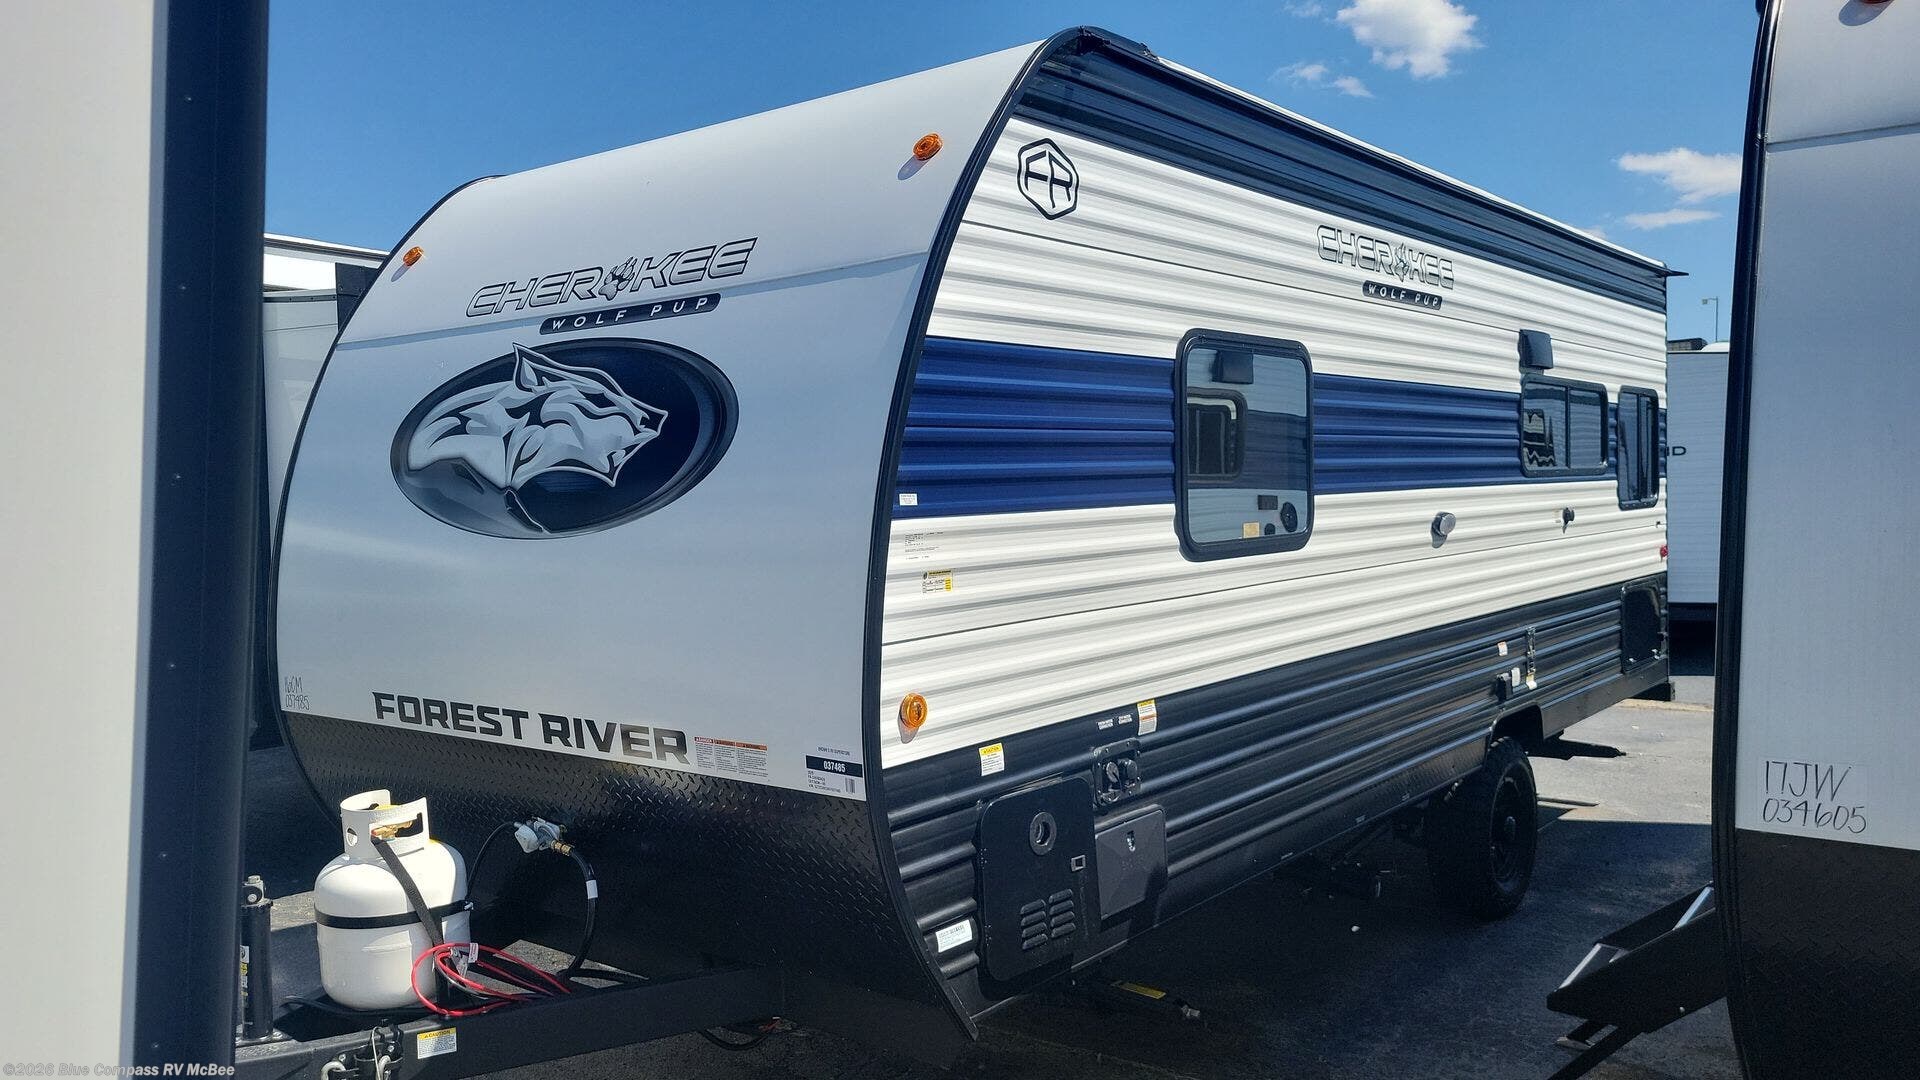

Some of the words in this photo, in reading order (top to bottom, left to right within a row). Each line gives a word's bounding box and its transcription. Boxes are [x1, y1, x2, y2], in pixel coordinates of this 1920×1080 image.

[1368, 283, 1407, 300] WOLF
[1414, 291, 1439, 307] PUP
[551, 309, 627, 331] WOLF
[649, 297, 708, 317] PUP
[371, 691, 529, 740] FOREST
[537, 712, 690, 765] RIVER
[823, 760, 846, 773] 037485
[1765, 760, 1852, 801] 17JW
[1762, 798, 1867, 834] 034605
